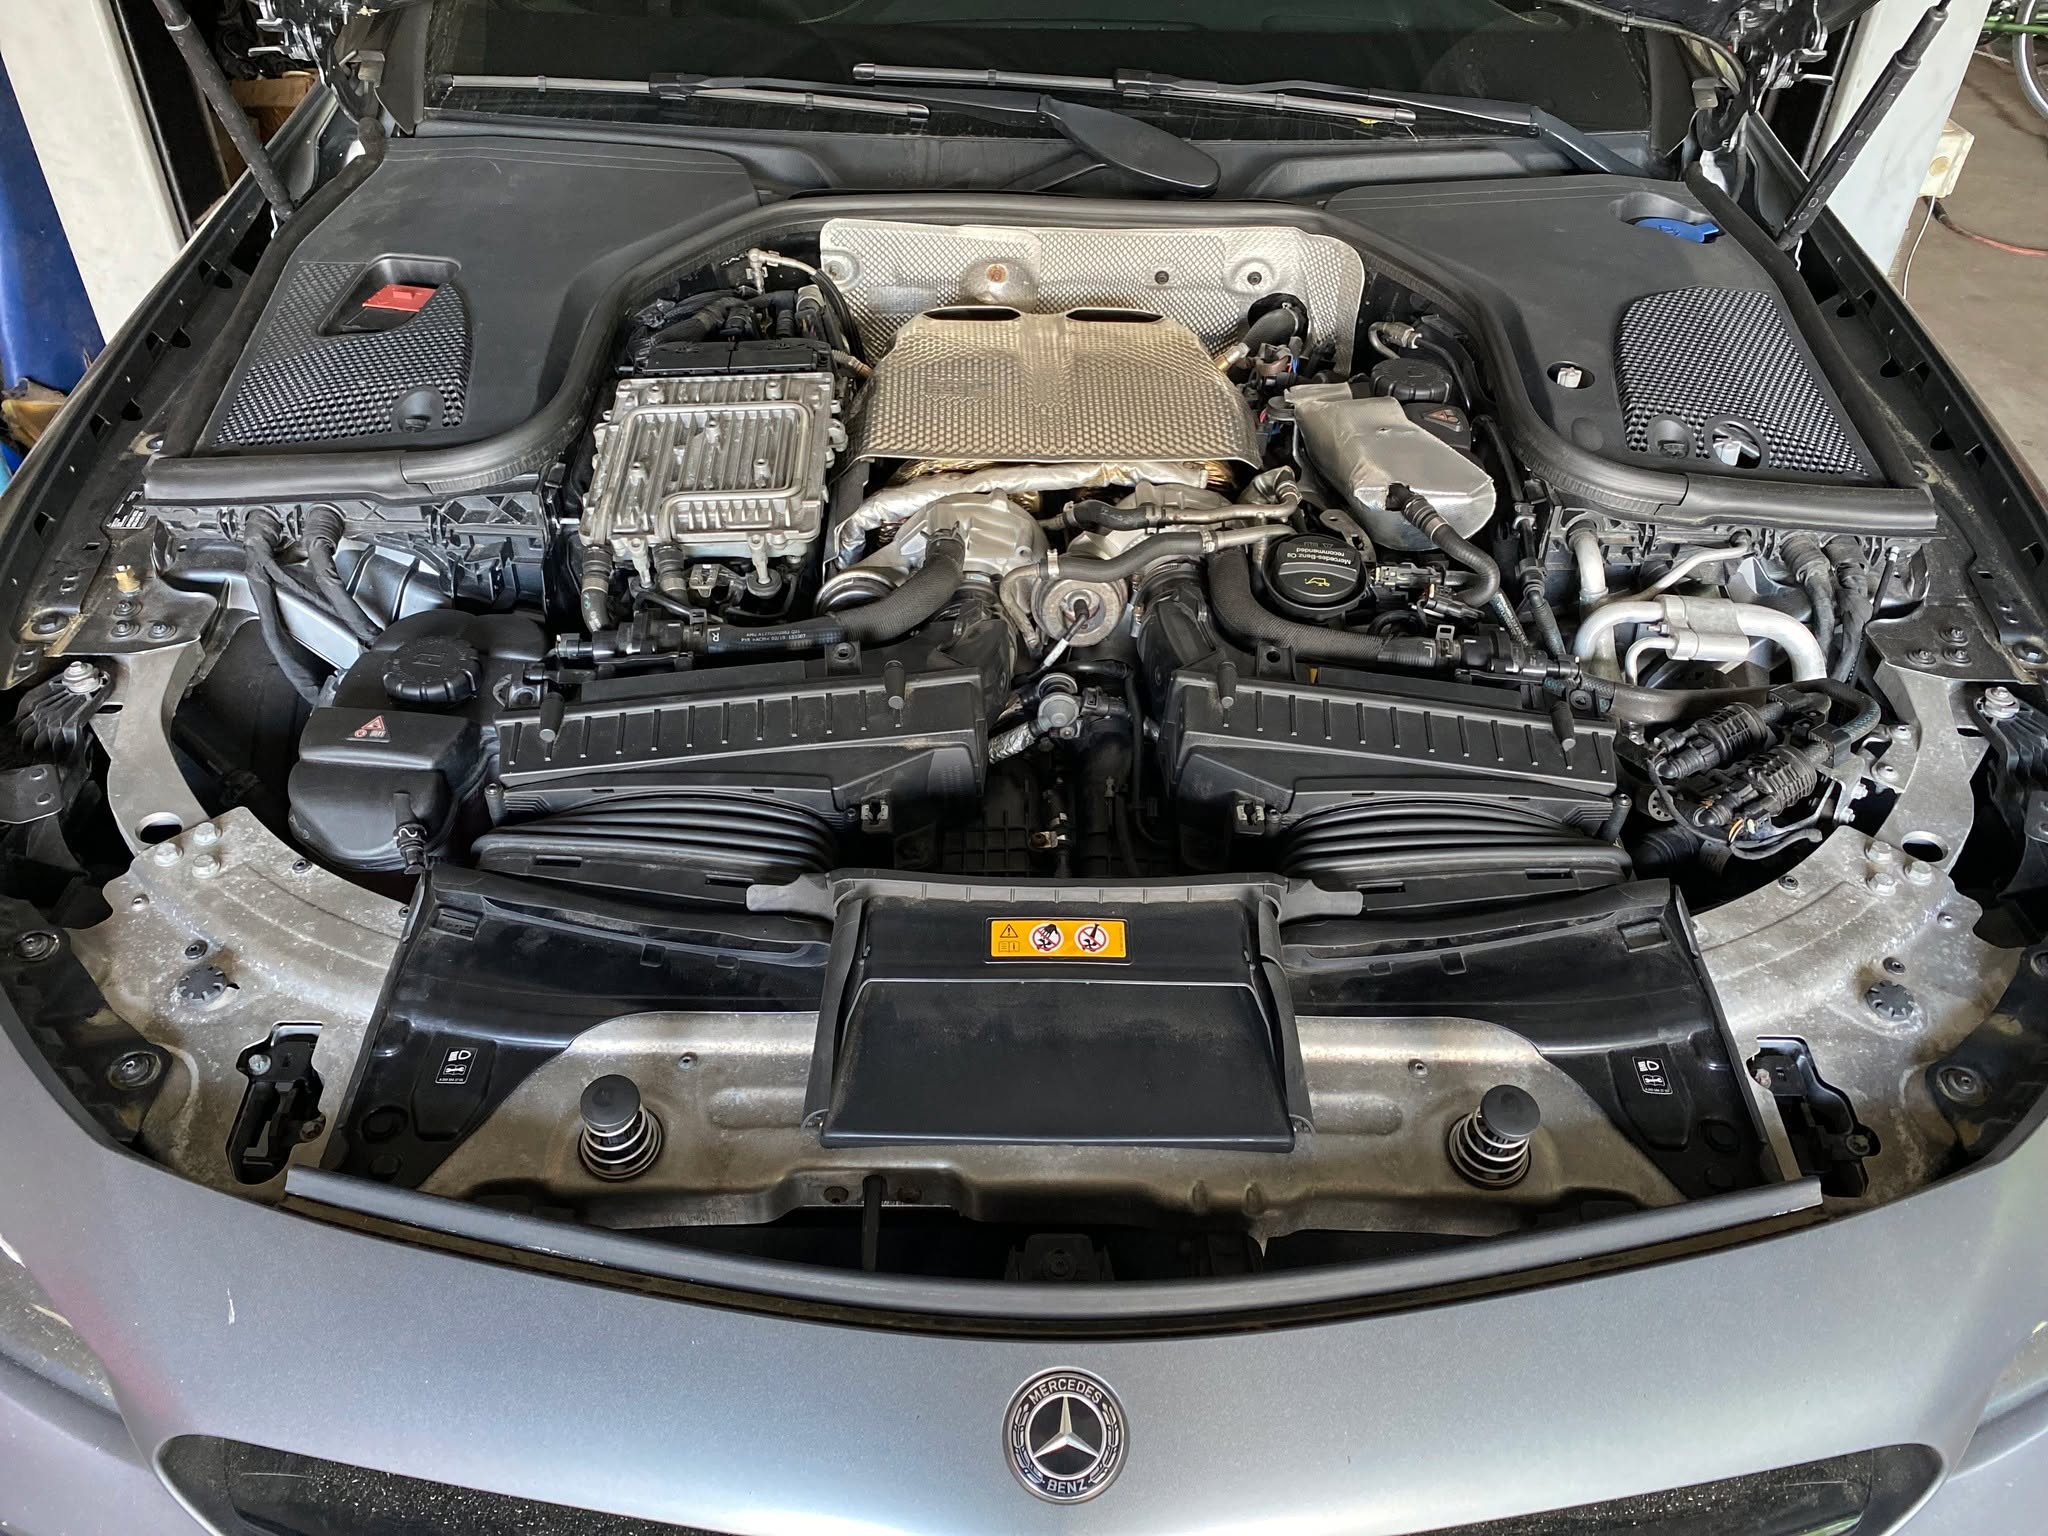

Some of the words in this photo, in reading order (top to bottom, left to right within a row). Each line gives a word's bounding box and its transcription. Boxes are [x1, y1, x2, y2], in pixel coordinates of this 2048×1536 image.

[1296, 547, 1345, 557] recommended
[711, 632, 720, 642] R
[1028, 1378, 1103, 1405] MERCEDES
[1046, 1479, 1088, 1494] BENZ
